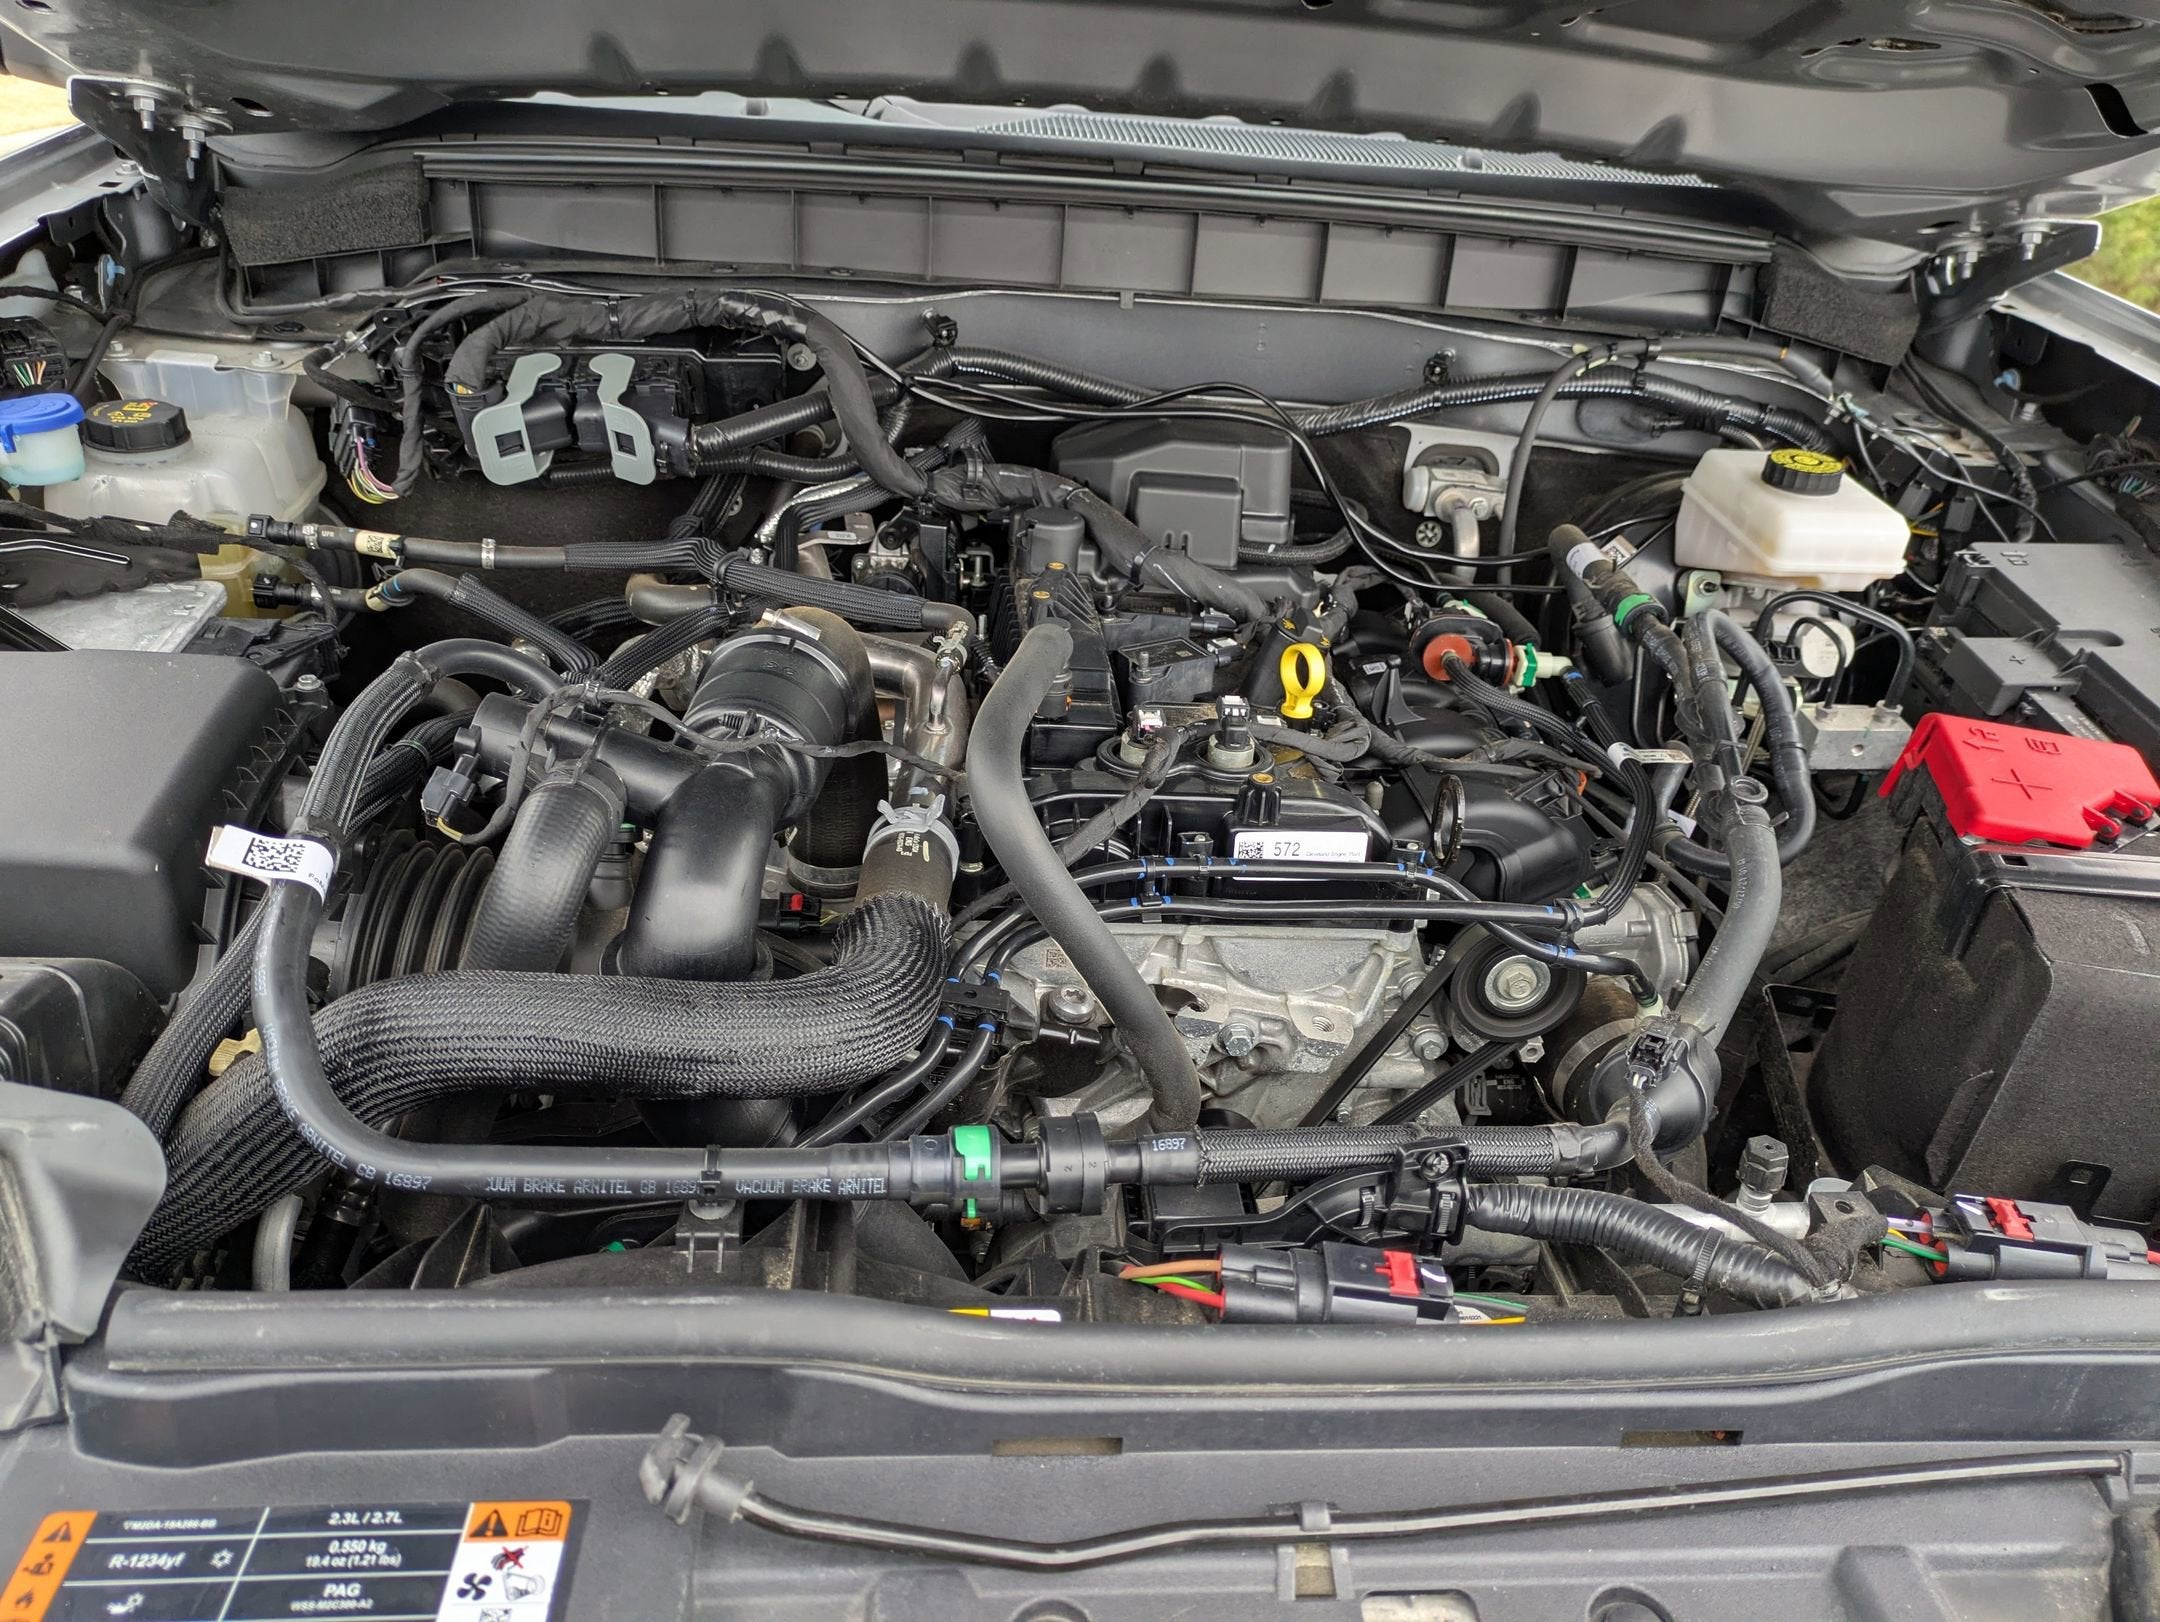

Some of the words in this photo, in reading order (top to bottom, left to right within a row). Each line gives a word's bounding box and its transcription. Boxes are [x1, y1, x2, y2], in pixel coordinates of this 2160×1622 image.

[1274, 842, 1301, 857] 572
[1331, 850, 1347, 858] Engine
[1151, 1137, 1187, 1152] 16897
[298, 1123, 348, 1170] ARNITEL
[384, 1170, 433, 1190] 16897
[523, 1178, 566, 1192] BRAKE
[573, 1179, 632, 1194] ARNITEL
[640, 1179, 656, 1193] GB
[734, 1180, 785, 1196] VACUUM
[792, 1178, 832, 1195] BRAKE
[838, 1178, 888, 1195] ARNITEL
[328, 1511, 360, 1526] 2.3L
[371, 1510, 403, 1525] 2.7L
[328, 1540, 366, 1555] 0.550
[368, 1538, 388, 1555] kg
[107, 1551, 187, 1571] R-1234yf
[331, 1557, 347, 1569] oz
[348, 1554, 378, 1570] (1.21
[322, 1583, 362, 1598] PAG
